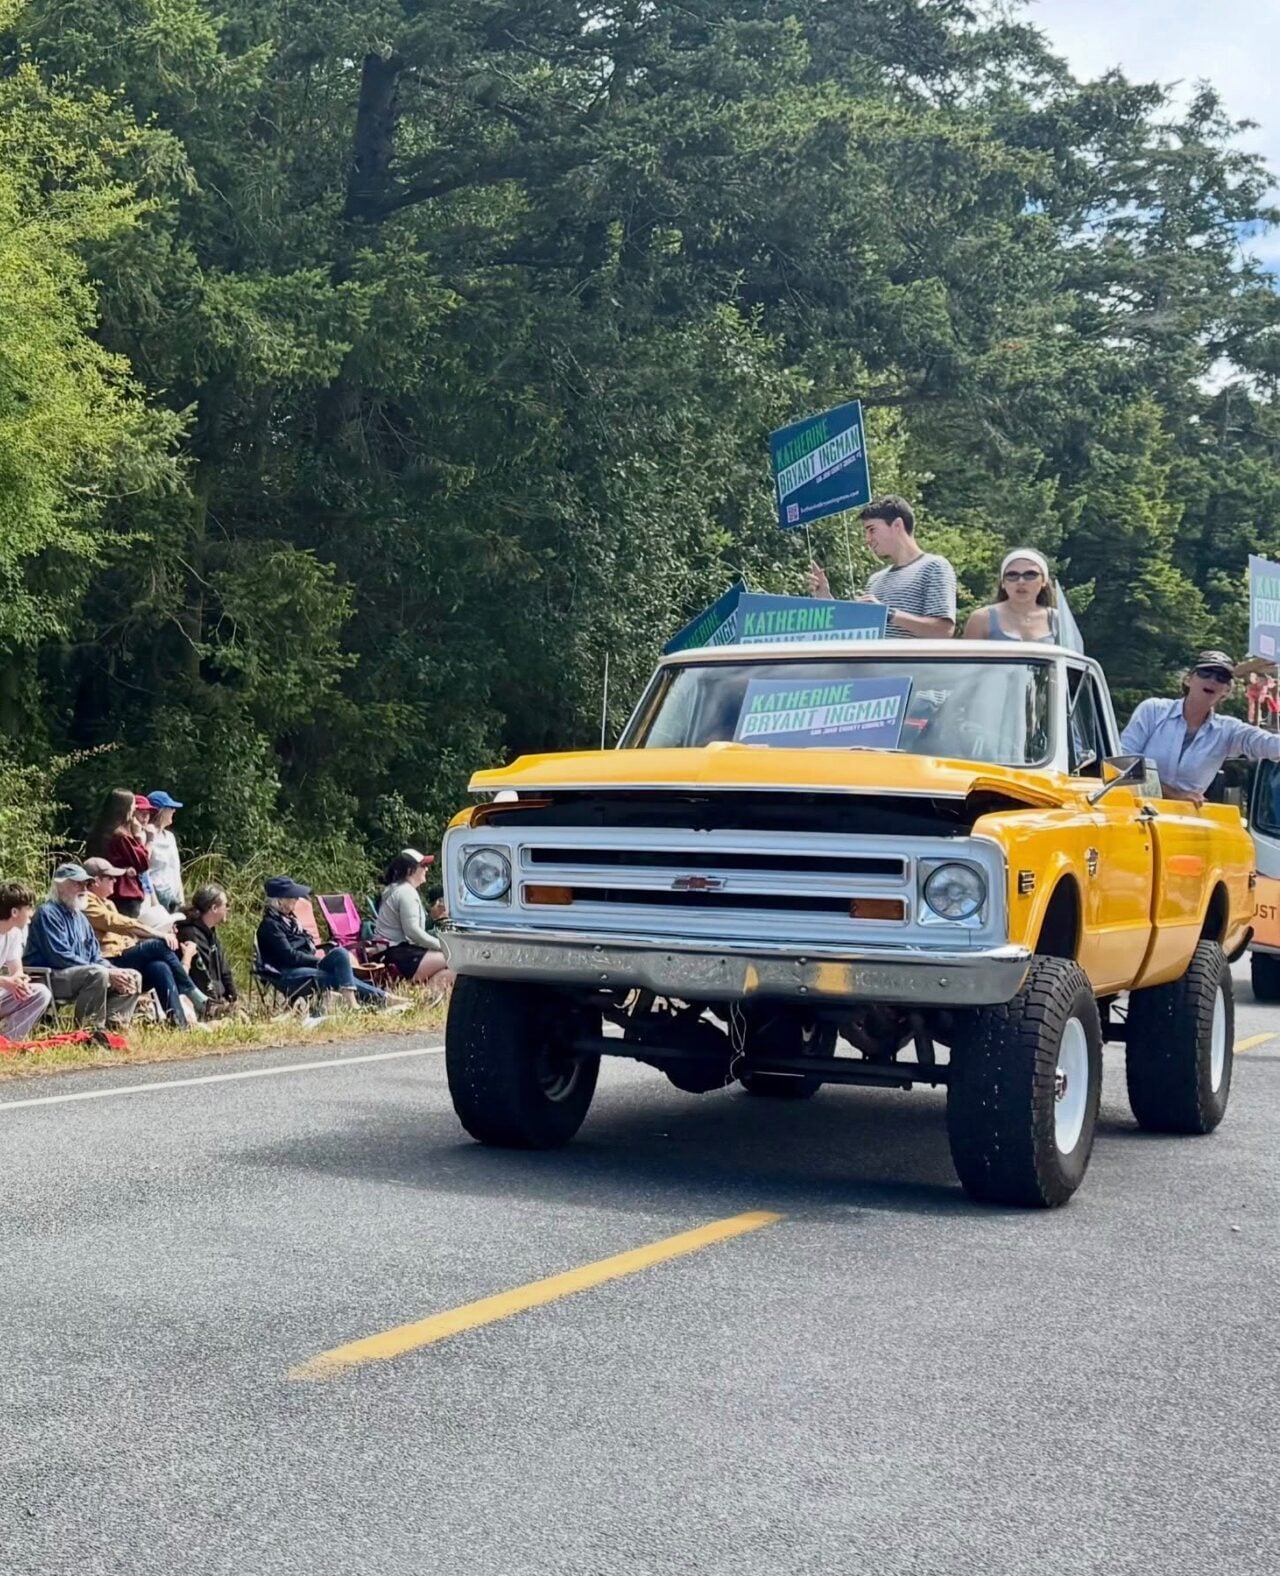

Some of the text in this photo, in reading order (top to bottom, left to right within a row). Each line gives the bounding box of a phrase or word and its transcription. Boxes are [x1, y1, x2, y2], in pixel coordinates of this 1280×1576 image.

[776, 418, 828, 471] KATHERINE
[779, 454, 817, 495] BRYANT
[819, 425, 860, 470] INGMAN
[743, 606, 836, 637] KATHERINE
[745, 709, 821, 734] BRYANT
[823, 698, 897, 726] INGMAN
[751, 683, 854, 713] KATHERINE
